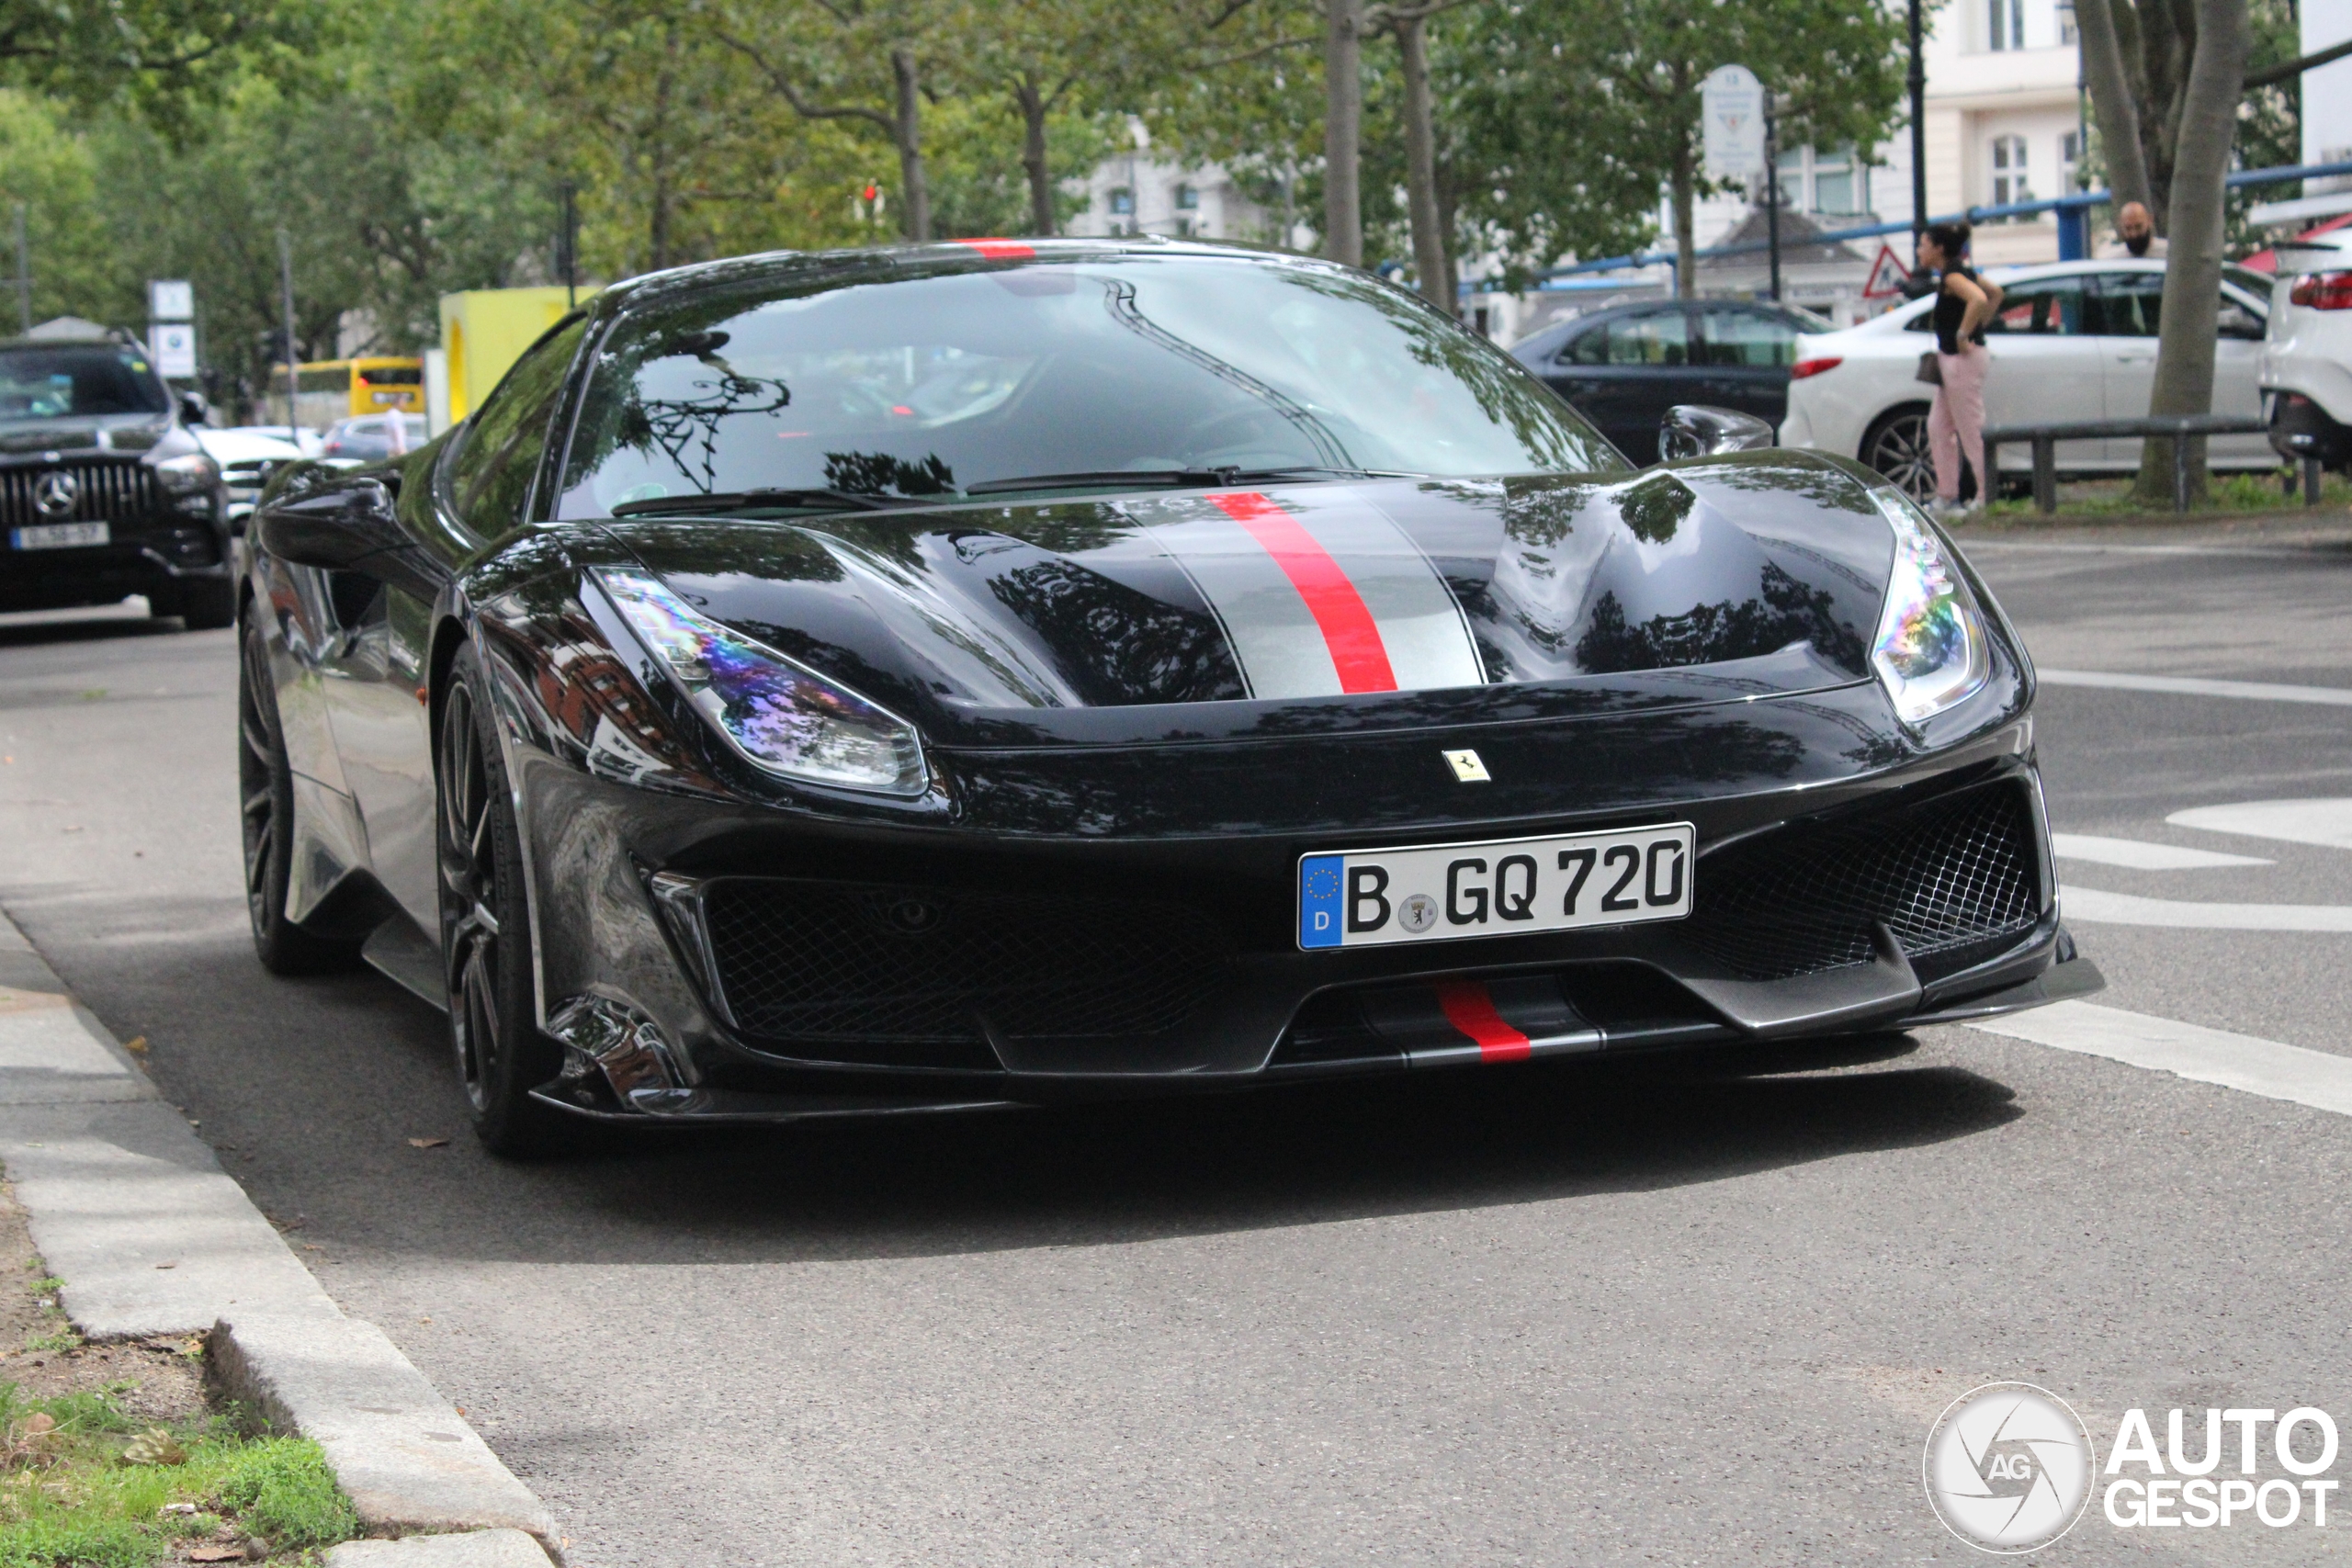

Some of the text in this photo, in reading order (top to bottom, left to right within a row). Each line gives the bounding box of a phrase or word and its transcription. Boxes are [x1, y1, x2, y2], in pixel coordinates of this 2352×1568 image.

[1347, 839, 1684, 933] B GQ 720
[1315, 911, 1329, 931] D
